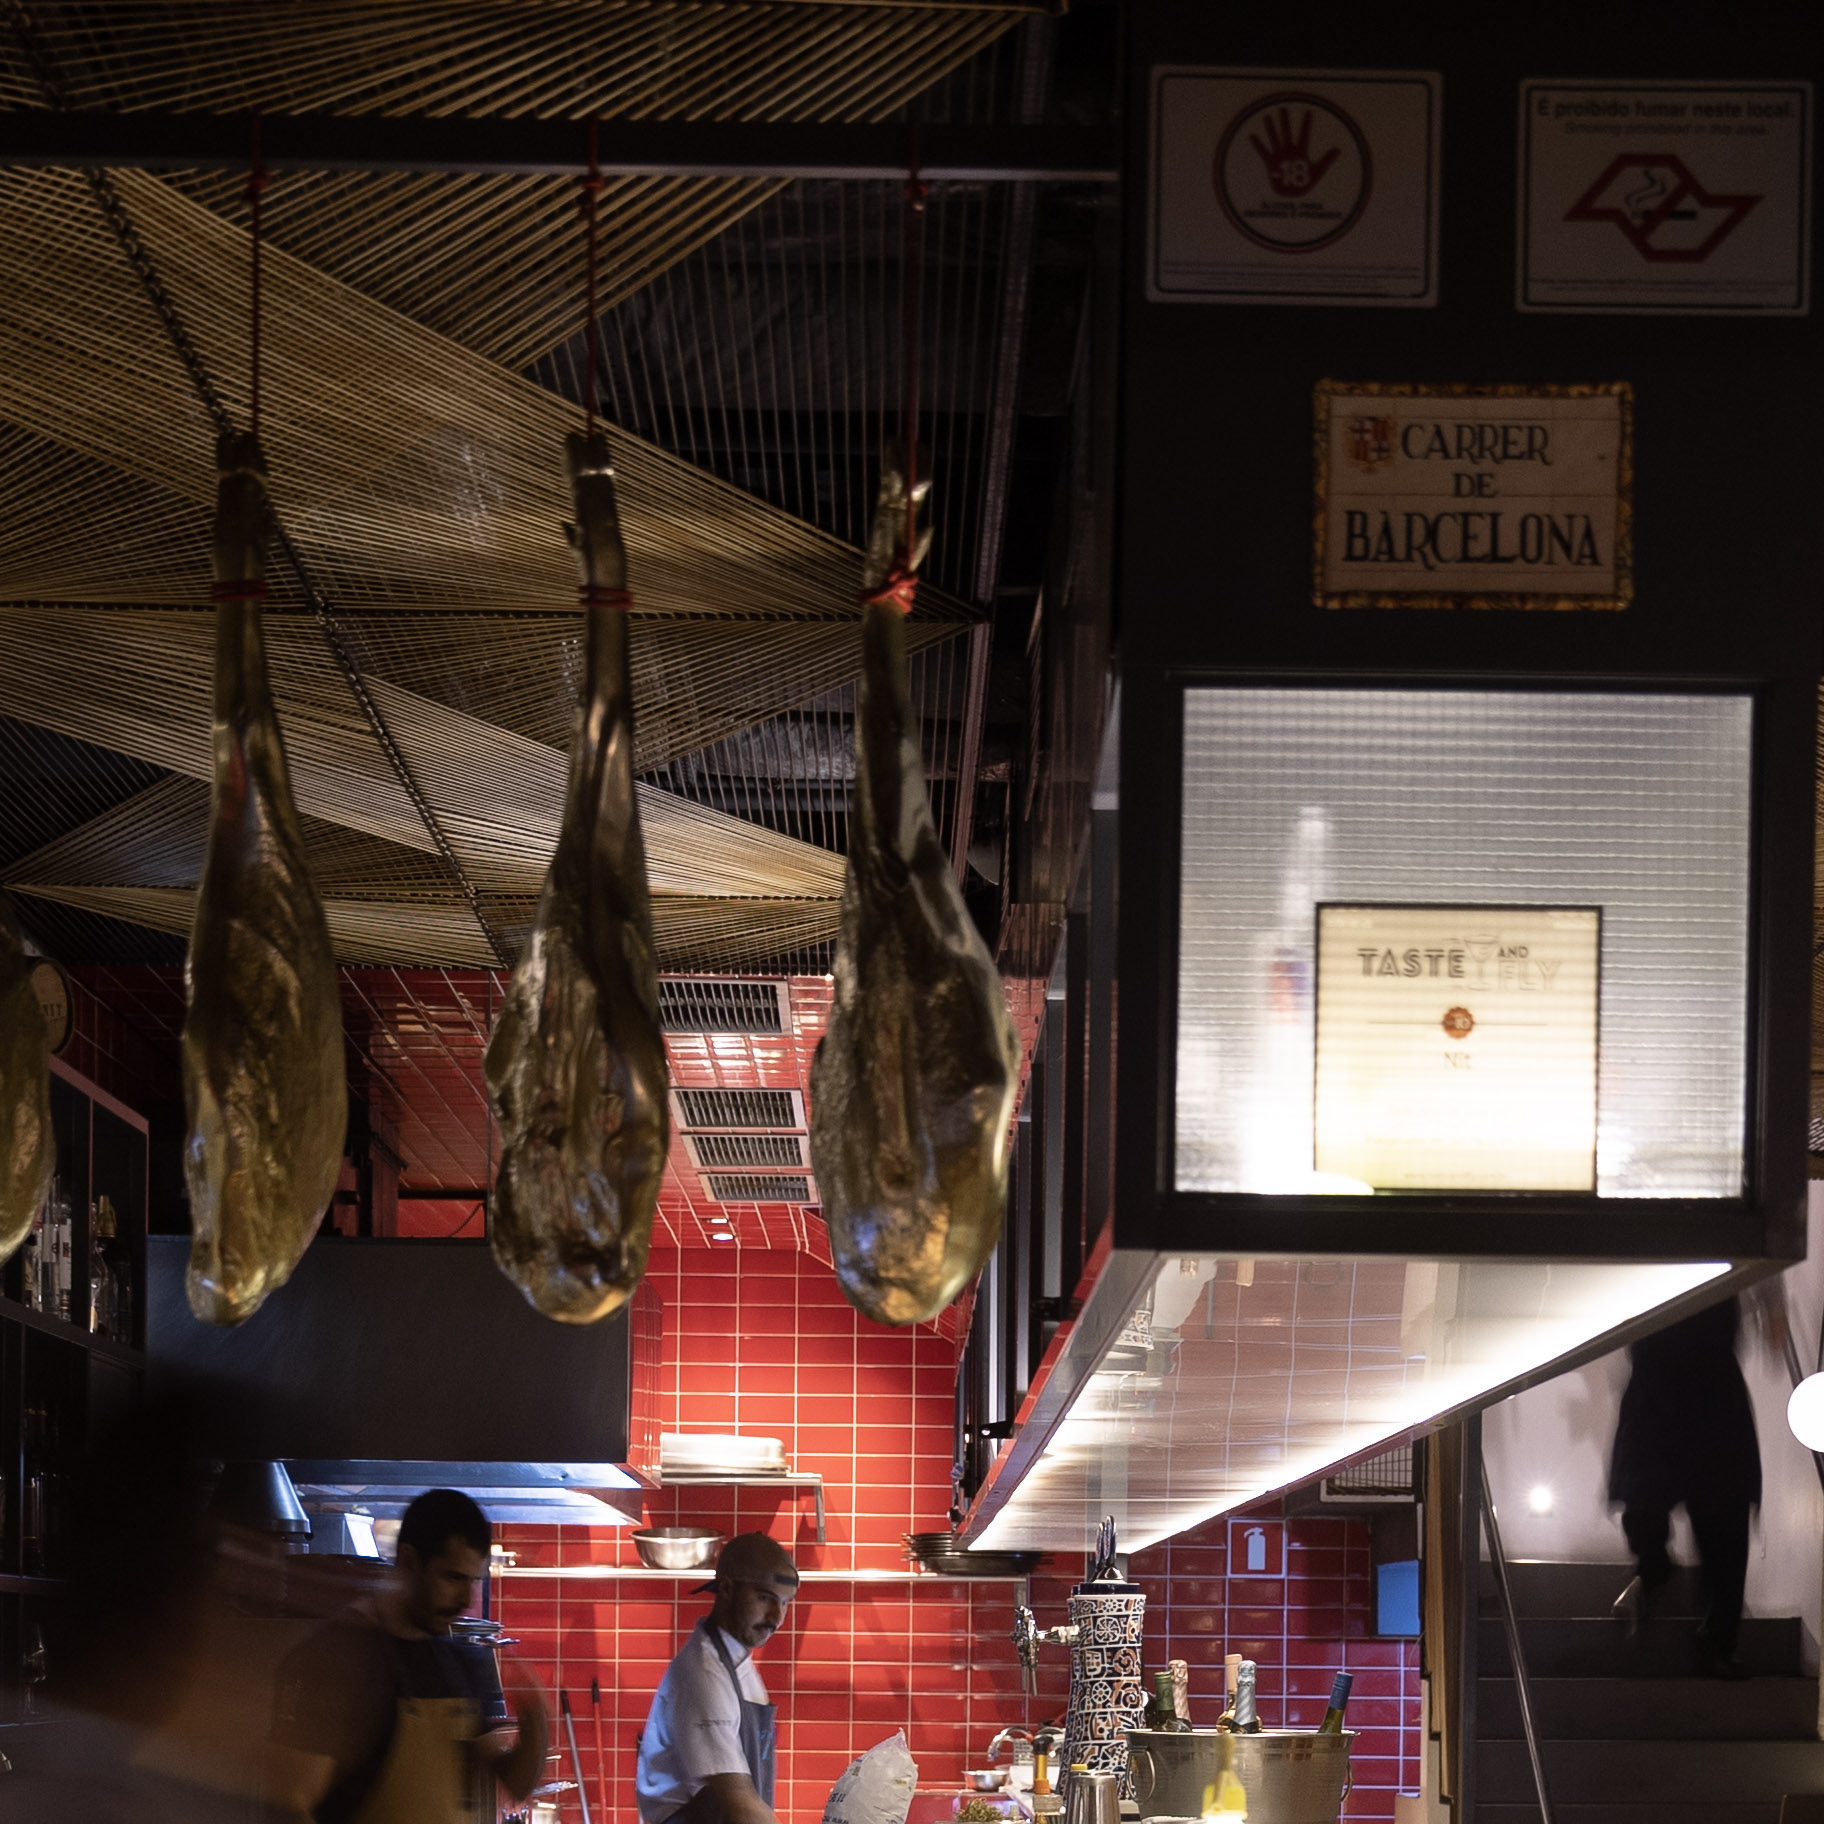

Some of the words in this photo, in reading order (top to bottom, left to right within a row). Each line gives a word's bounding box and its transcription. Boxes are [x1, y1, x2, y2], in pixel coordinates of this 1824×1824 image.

[1555, 101, 1629, 119] proibido
[1635, 102, 1688, 117] fumar
[1693, 104, 1740, 118] neste
[1402, 422, 1552, 466] CARRER
[1453, 472, 1496, 499] DE
[1342, 512, 1603, 570] BARCELONA
[1356, 947, 1465, 979] TASTE
[1497, 945, 1529, 959] AND
[1497, 960, 1563, 991] FLY
